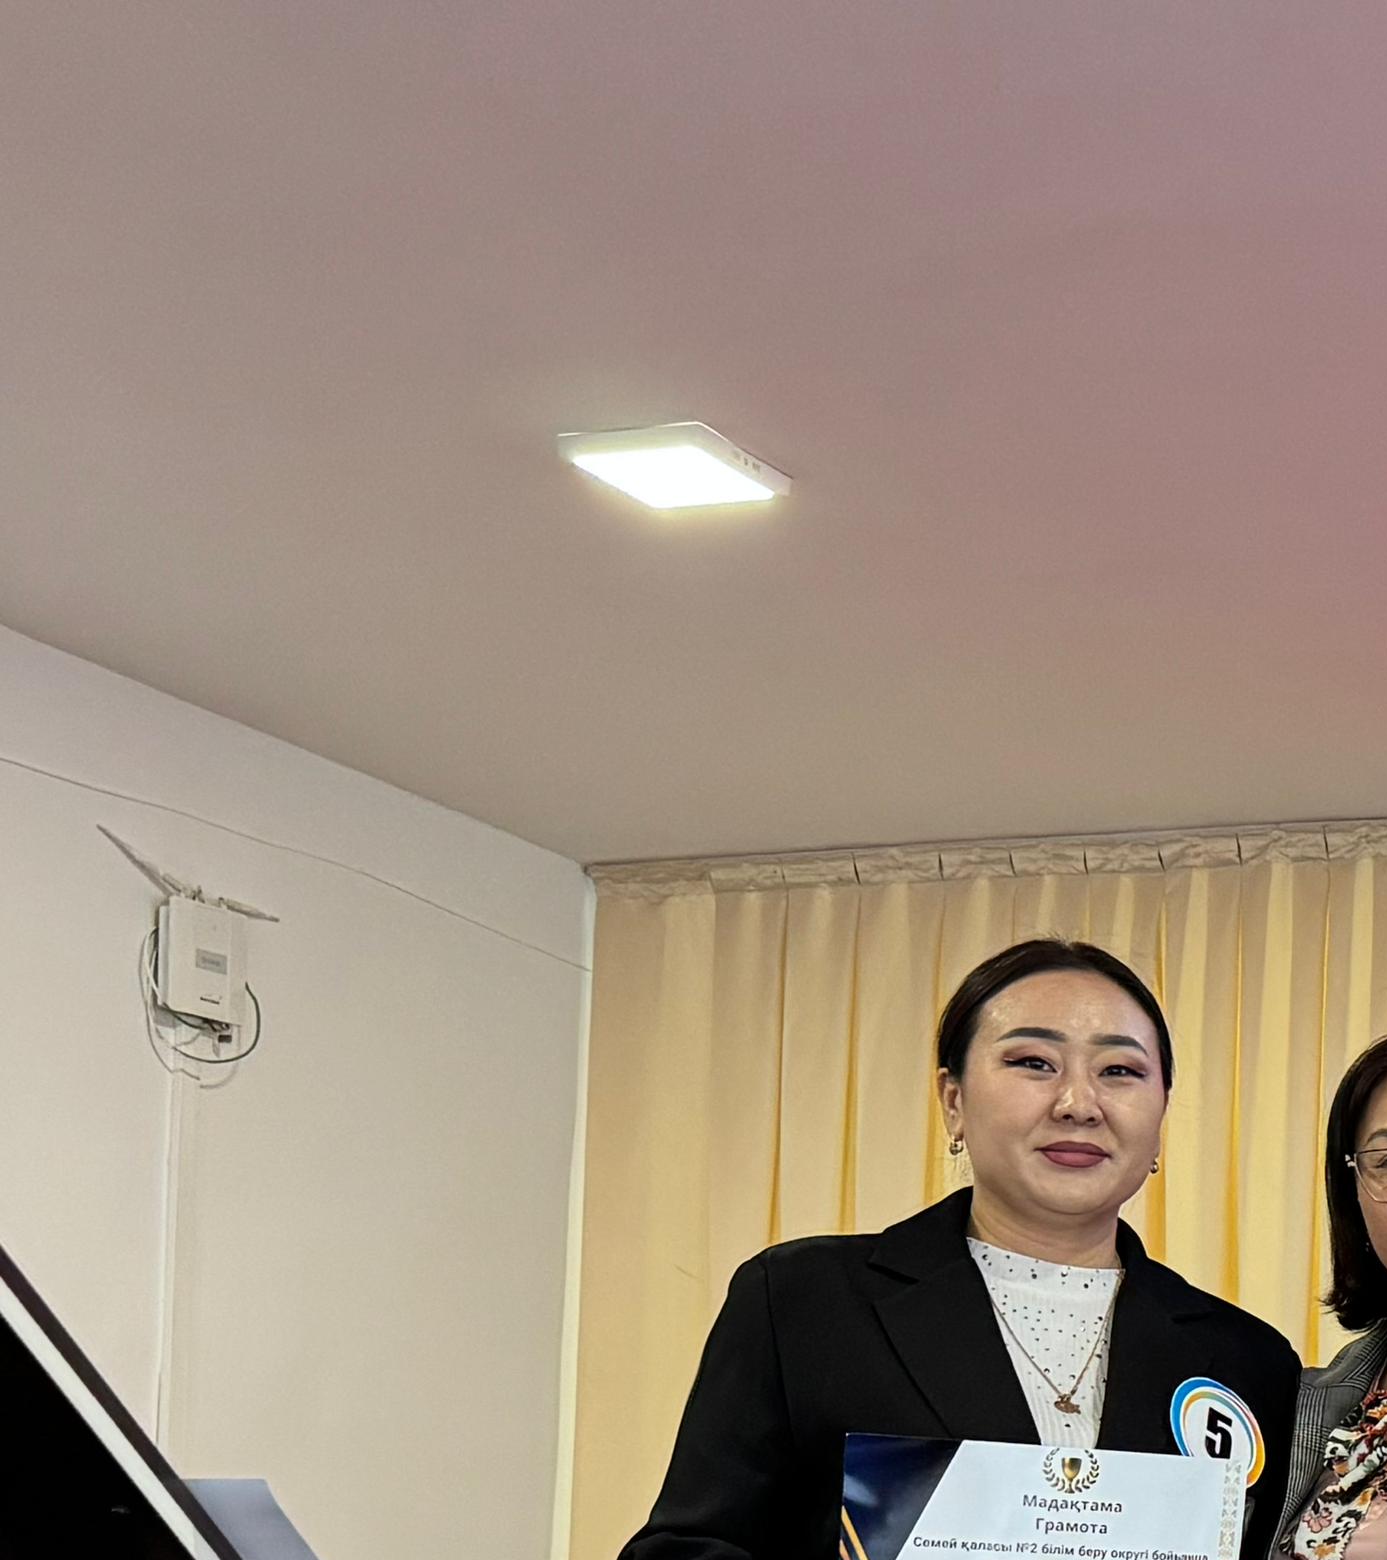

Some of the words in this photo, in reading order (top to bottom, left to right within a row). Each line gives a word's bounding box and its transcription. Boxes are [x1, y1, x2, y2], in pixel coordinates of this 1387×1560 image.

[1205, 1407, 1232, 1460] 5
[1022, 1494, 1123, 1513] Мадақтама
[1036, 1517, 1108, 1535] Грамота
[913, 1536, 957, 1549] Семей
[961, 1540, 1012, 1552] қаласы
[1016, 1542, 1038, 1553] №2
[1042, 1543, 1074, 1555] білім
[1078, 1545, 1108, 1560] беру
[1111, 1549, 1149, 1560] округі
